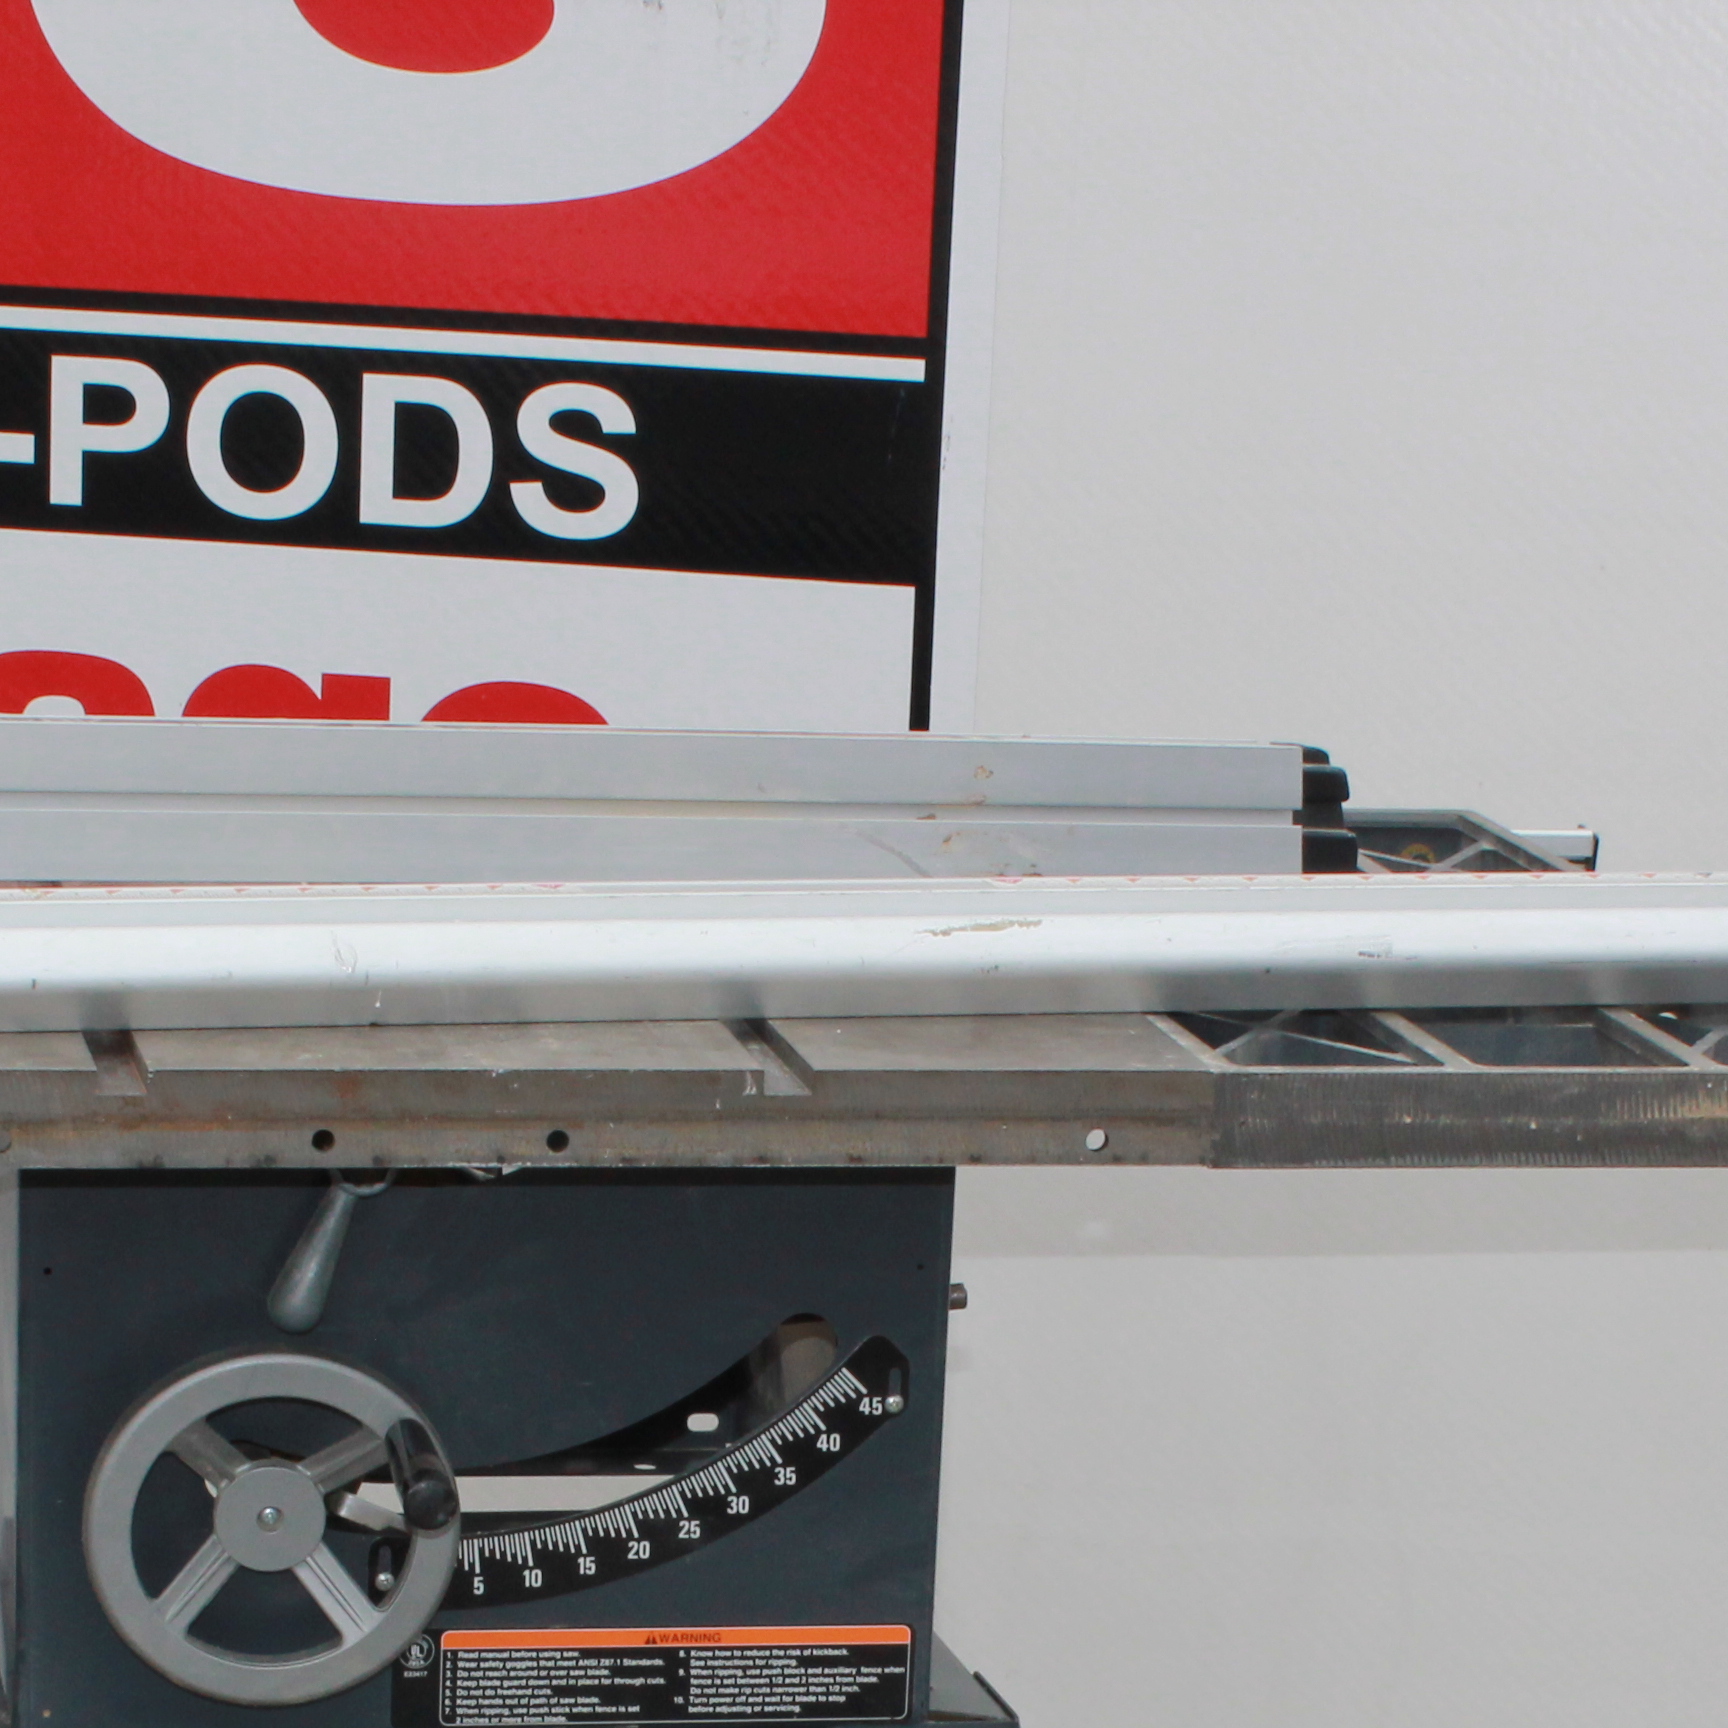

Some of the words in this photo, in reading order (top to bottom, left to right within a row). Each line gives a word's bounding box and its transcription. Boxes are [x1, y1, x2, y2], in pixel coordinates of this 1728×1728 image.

[860, 1398, 883, 1415] 45
[817, 1434, 841, 1452] 40
[775, 1467, 796, 1486] 35
[728, 1497, 749, 1514] 30
[679, 1521, 700, 1539] 25
[628, 1542, 650, 1559] 20
[577, 1557, 596, 1575] 15
[474, 1577, 484, 1595] 5
[524, 1569, 542, 1587] 10
[659, 1632, 722, 1644] WARNING
